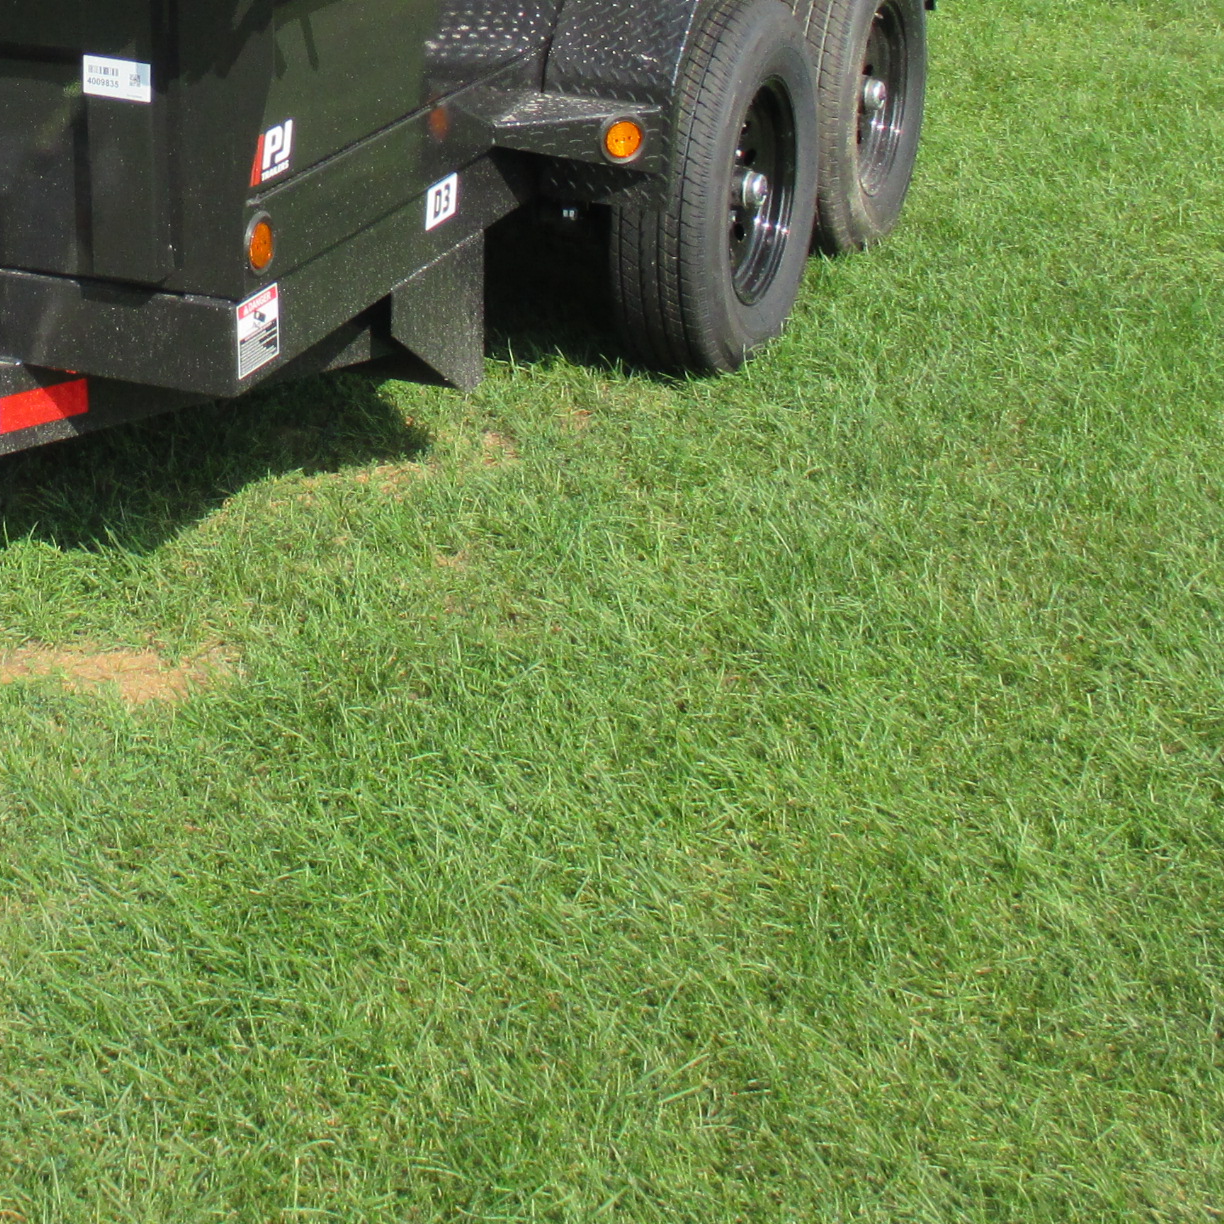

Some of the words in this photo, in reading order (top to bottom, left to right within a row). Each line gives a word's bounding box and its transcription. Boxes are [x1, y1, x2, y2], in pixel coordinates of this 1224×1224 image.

[87, 76, 120, 89] 4009835
[262, 118, 294, 171] PJ
[433, 182, 451, 220] D3
[247, 290, 272, 312] DANGER
